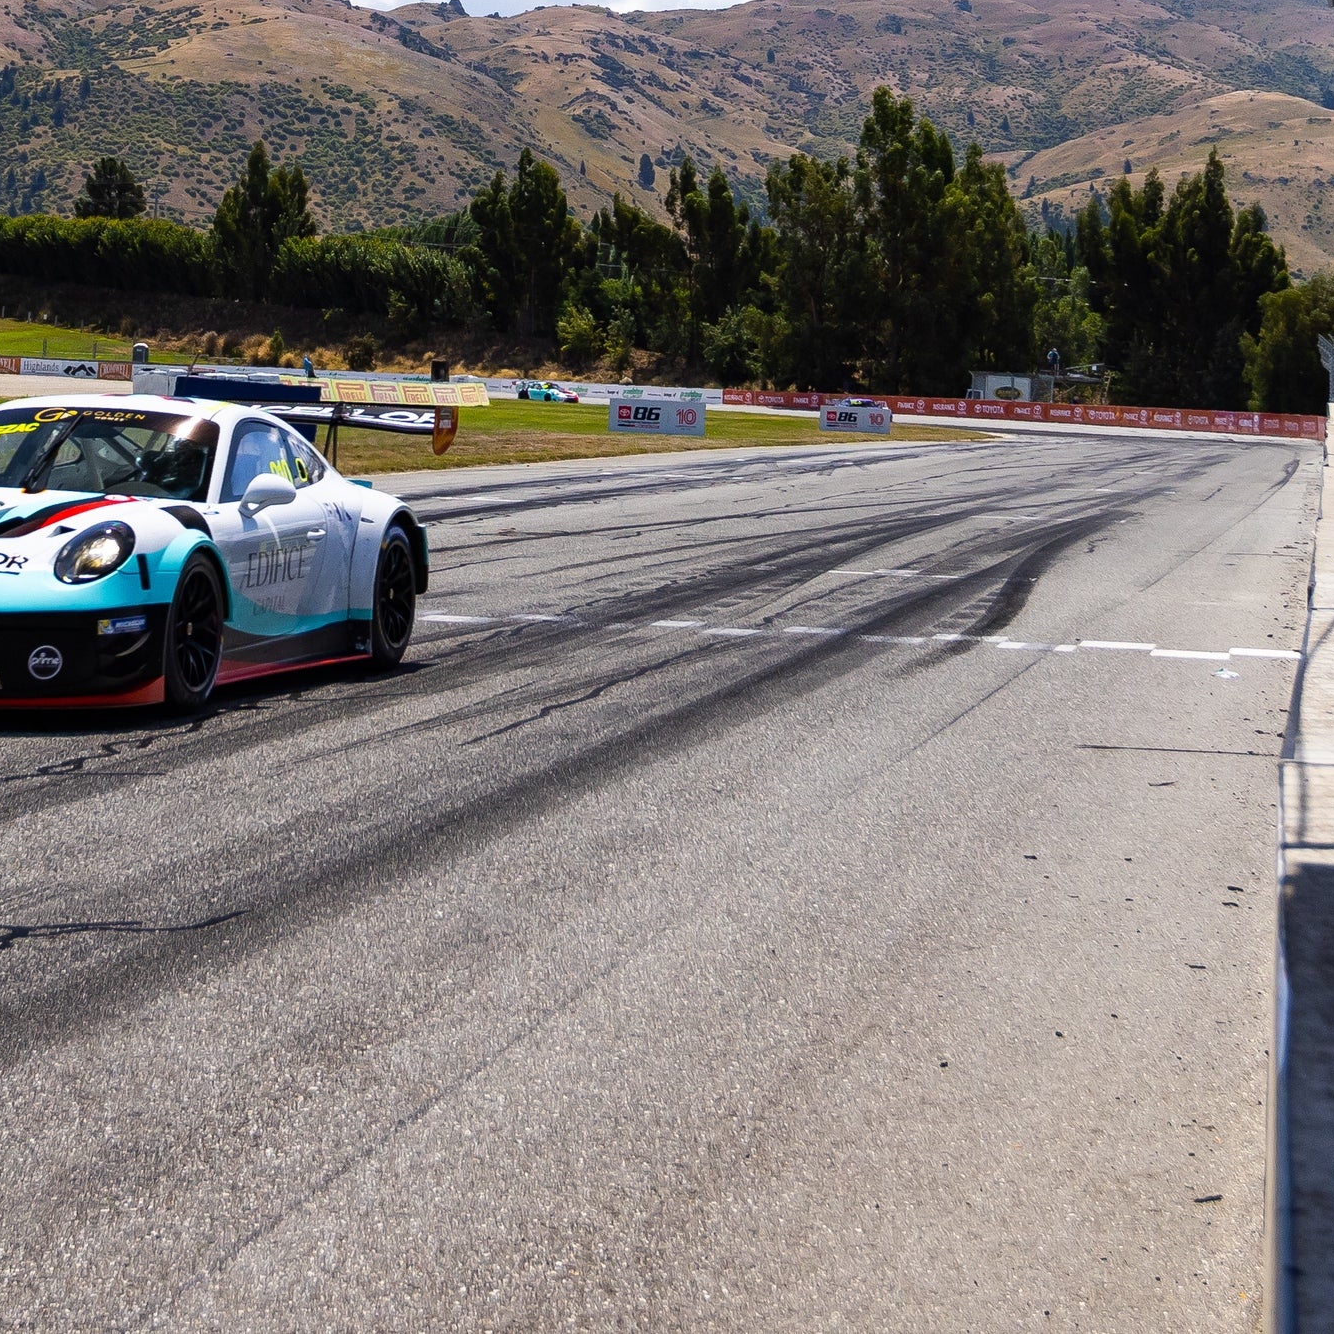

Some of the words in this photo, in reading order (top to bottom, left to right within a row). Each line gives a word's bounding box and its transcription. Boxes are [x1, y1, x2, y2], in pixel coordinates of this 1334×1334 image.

[22, 361, 60, 374] Highlands
[336, 382, 366, 401] PIRELLI
[370, 384, 399, 402] PIRELLI
[402, 387, 430, 404] PIRELLI
[432, 388, 458, 404] PIRELLI
[82, 410, 146, 421] GOLDEN
[633, 406, 662, 421] 86
[676, 408, 697, 425] 10
[982, 405, 1004, 414] TOYOTA
[1095, 411, 1116, 420] TOYOTA
[837, 411, 858, 423] 86
[868, 413, 885, 426] 10
